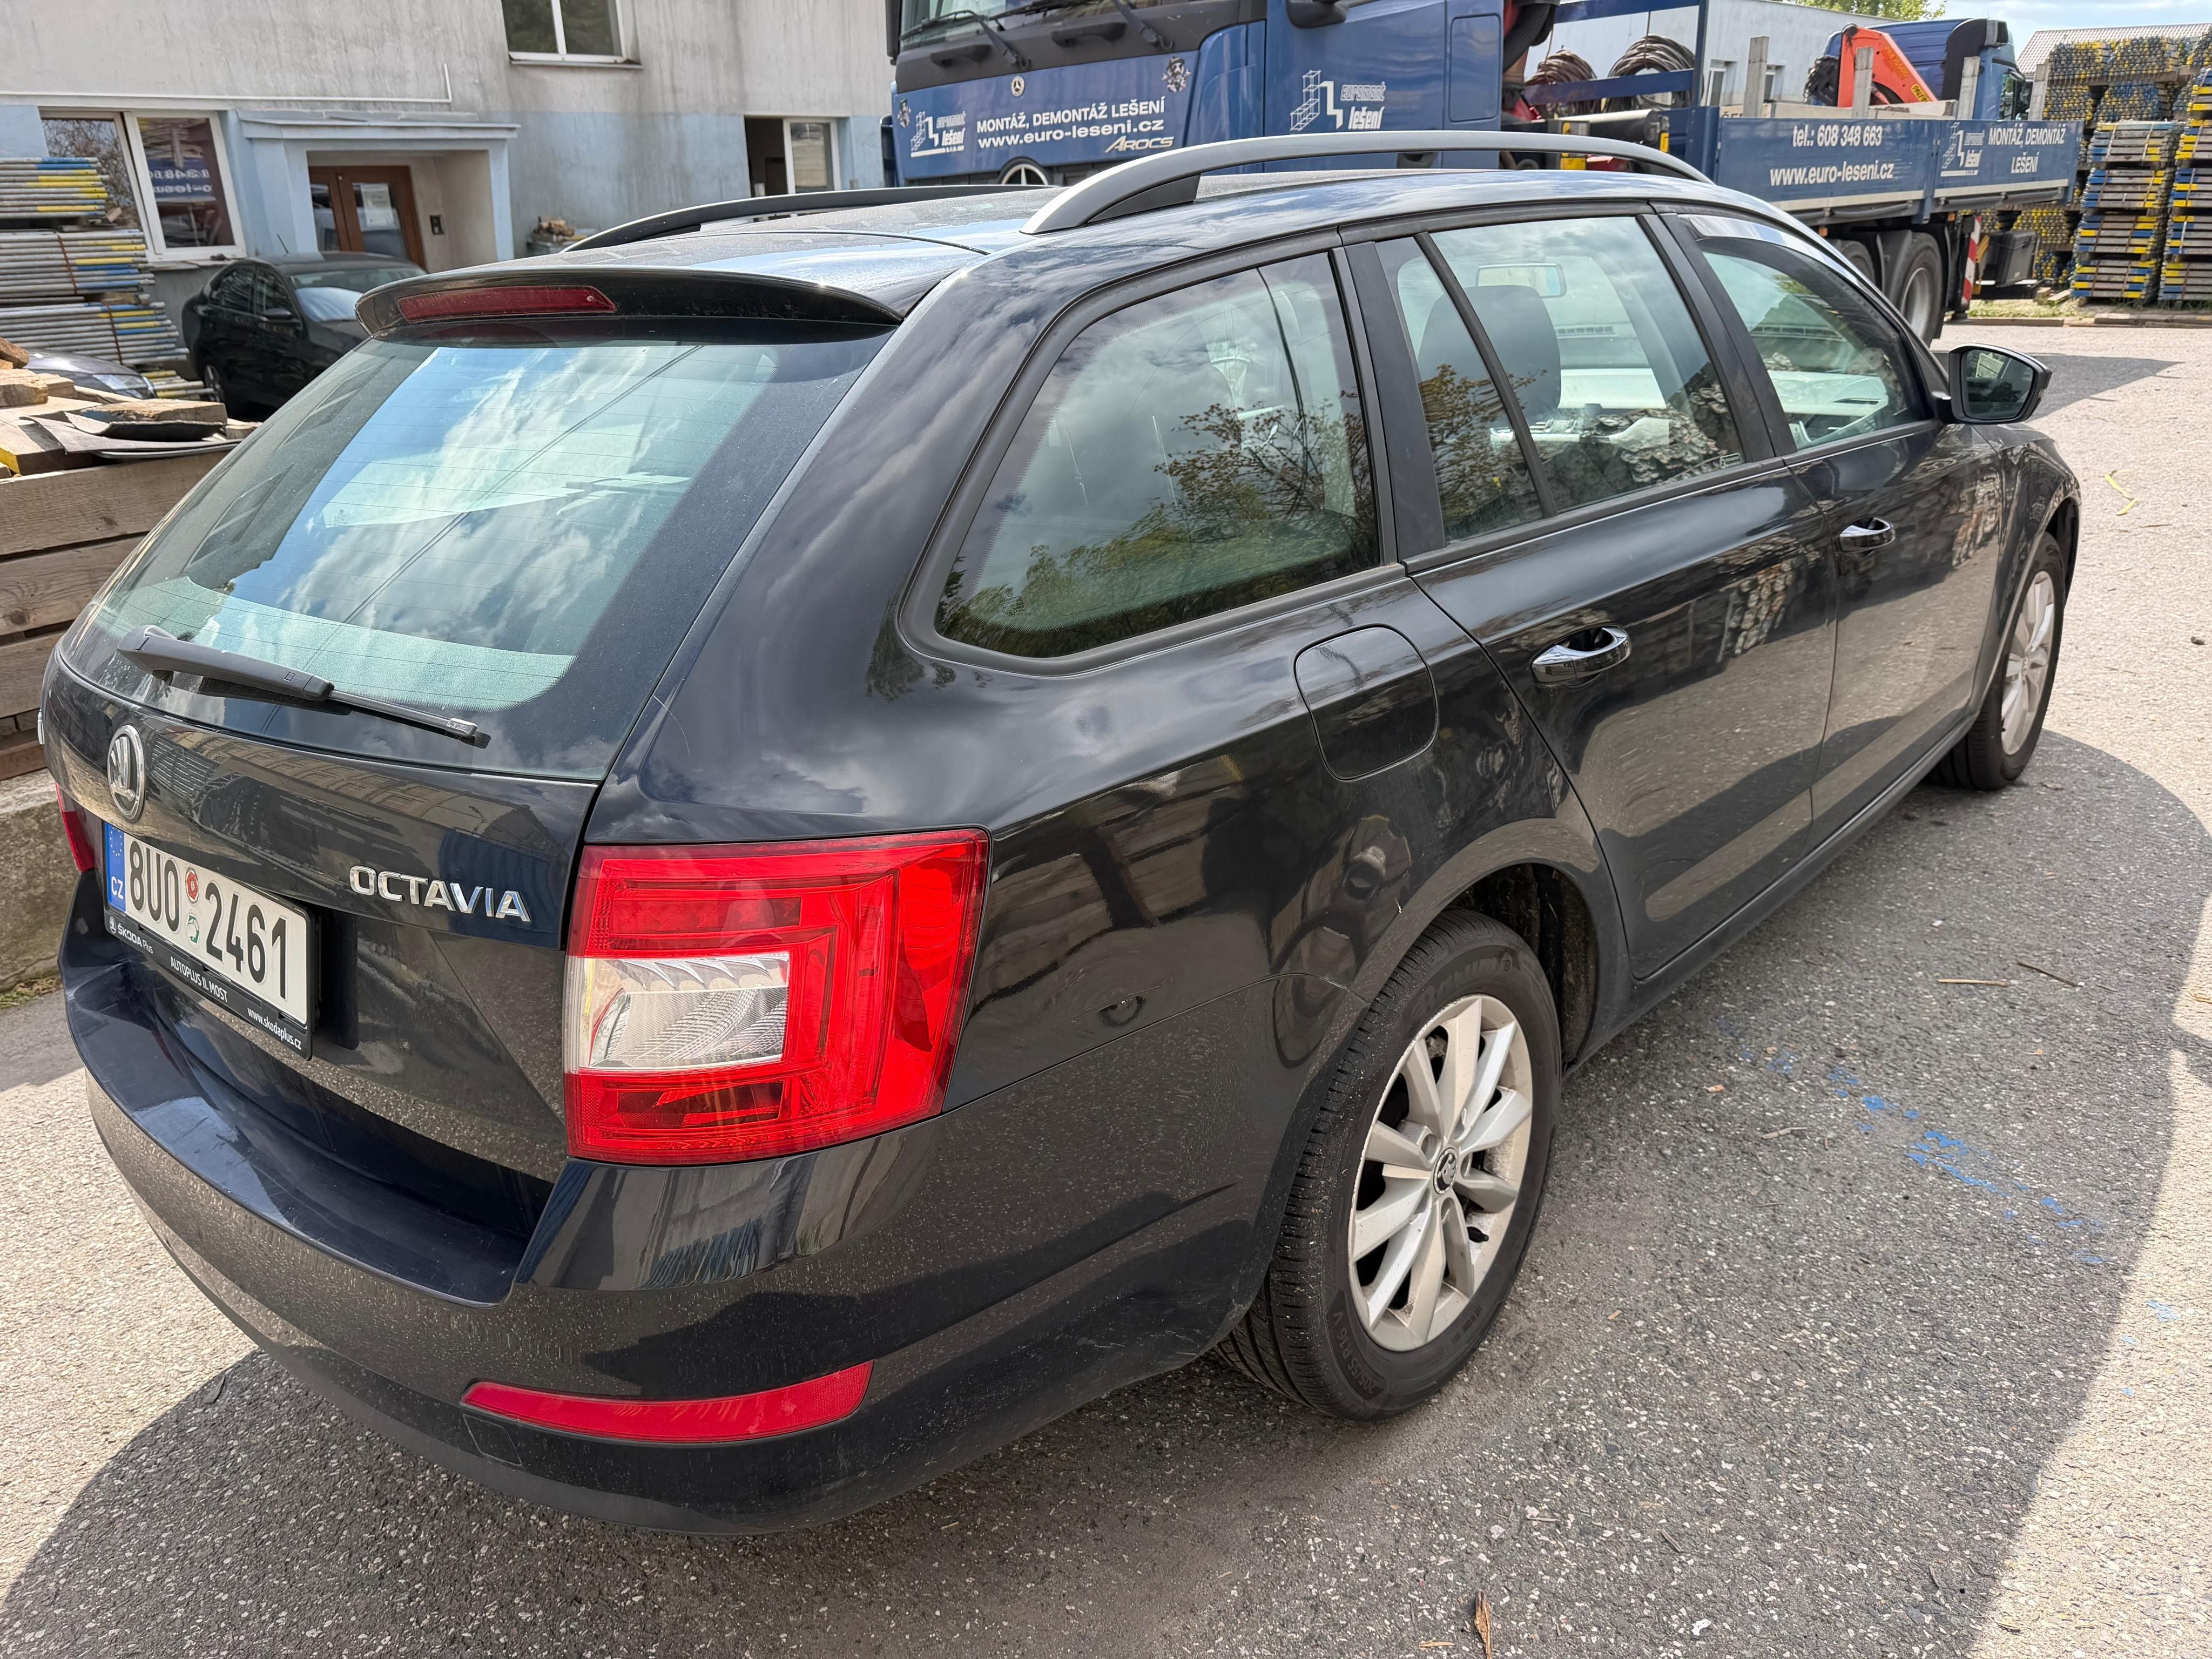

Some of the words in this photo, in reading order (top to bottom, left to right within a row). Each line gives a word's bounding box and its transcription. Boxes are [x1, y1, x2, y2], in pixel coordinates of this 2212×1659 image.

[976, 112, 1030, 133] MONTÁŽ,
[1033, 102, 1108, 126] DEMONTÁŽ
[1111, 96, 1166, 118] LEŠENÍ
[1348, 106, 1385, 130] lešení
[977, 119, 1164, 149] www.euro-leseni.cz
[1792, 125, 1815, 147] tel.:
[1817, 125, 1839, 147] 608
[1840, 125, 1862, 146] 348
[1863, 125, 1883, 146] 663
[1988, 123, 2024, 148] MONTÁŽ,
[2025, 124, 2067, 145] DEMONTÁŽ
[1770, 159, 1895, 186] www.euro-leseni.cz
[2010, 151, 2040, 174] LEŠENÍ
[349, 865, 531, 922] OCTAVIA
[111, 875, 124, 900] CZ
[205, 882, 287, 1000] 2461
[117, 923, 143, 949] ŠKODA
[170, 956, 201, 990] AUTOPLUS
[209, 982, 228, 1002] MOST
[247, 1007, 301, 1050] www.skodaplus.cz
[1336, 1326, 1353, 1360] R16
[1347, 1357, 1377, 1394] 205/55
